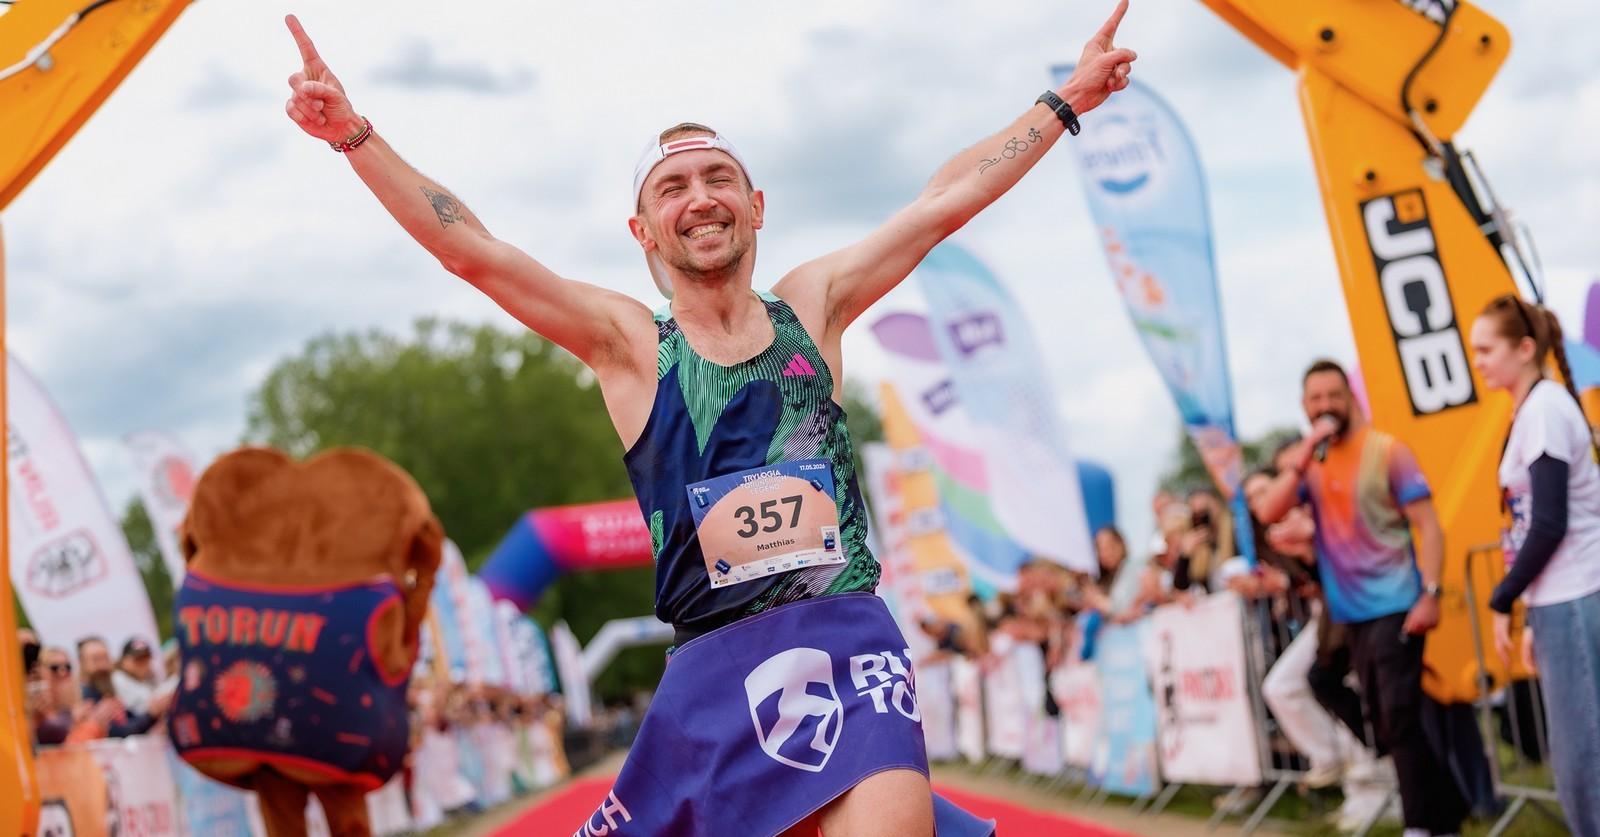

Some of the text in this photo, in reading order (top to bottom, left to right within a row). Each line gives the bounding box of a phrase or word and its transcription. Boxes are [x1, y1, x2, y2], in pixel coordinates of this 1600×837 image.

[1363, 196, 1473, 414] JCB
[742, 469, 782, 483] TRYLOGIA
[734, 494, 804, 539] 357
[757, 538, 795, 552] Matthias
[849, 648, 914, 691] RU
